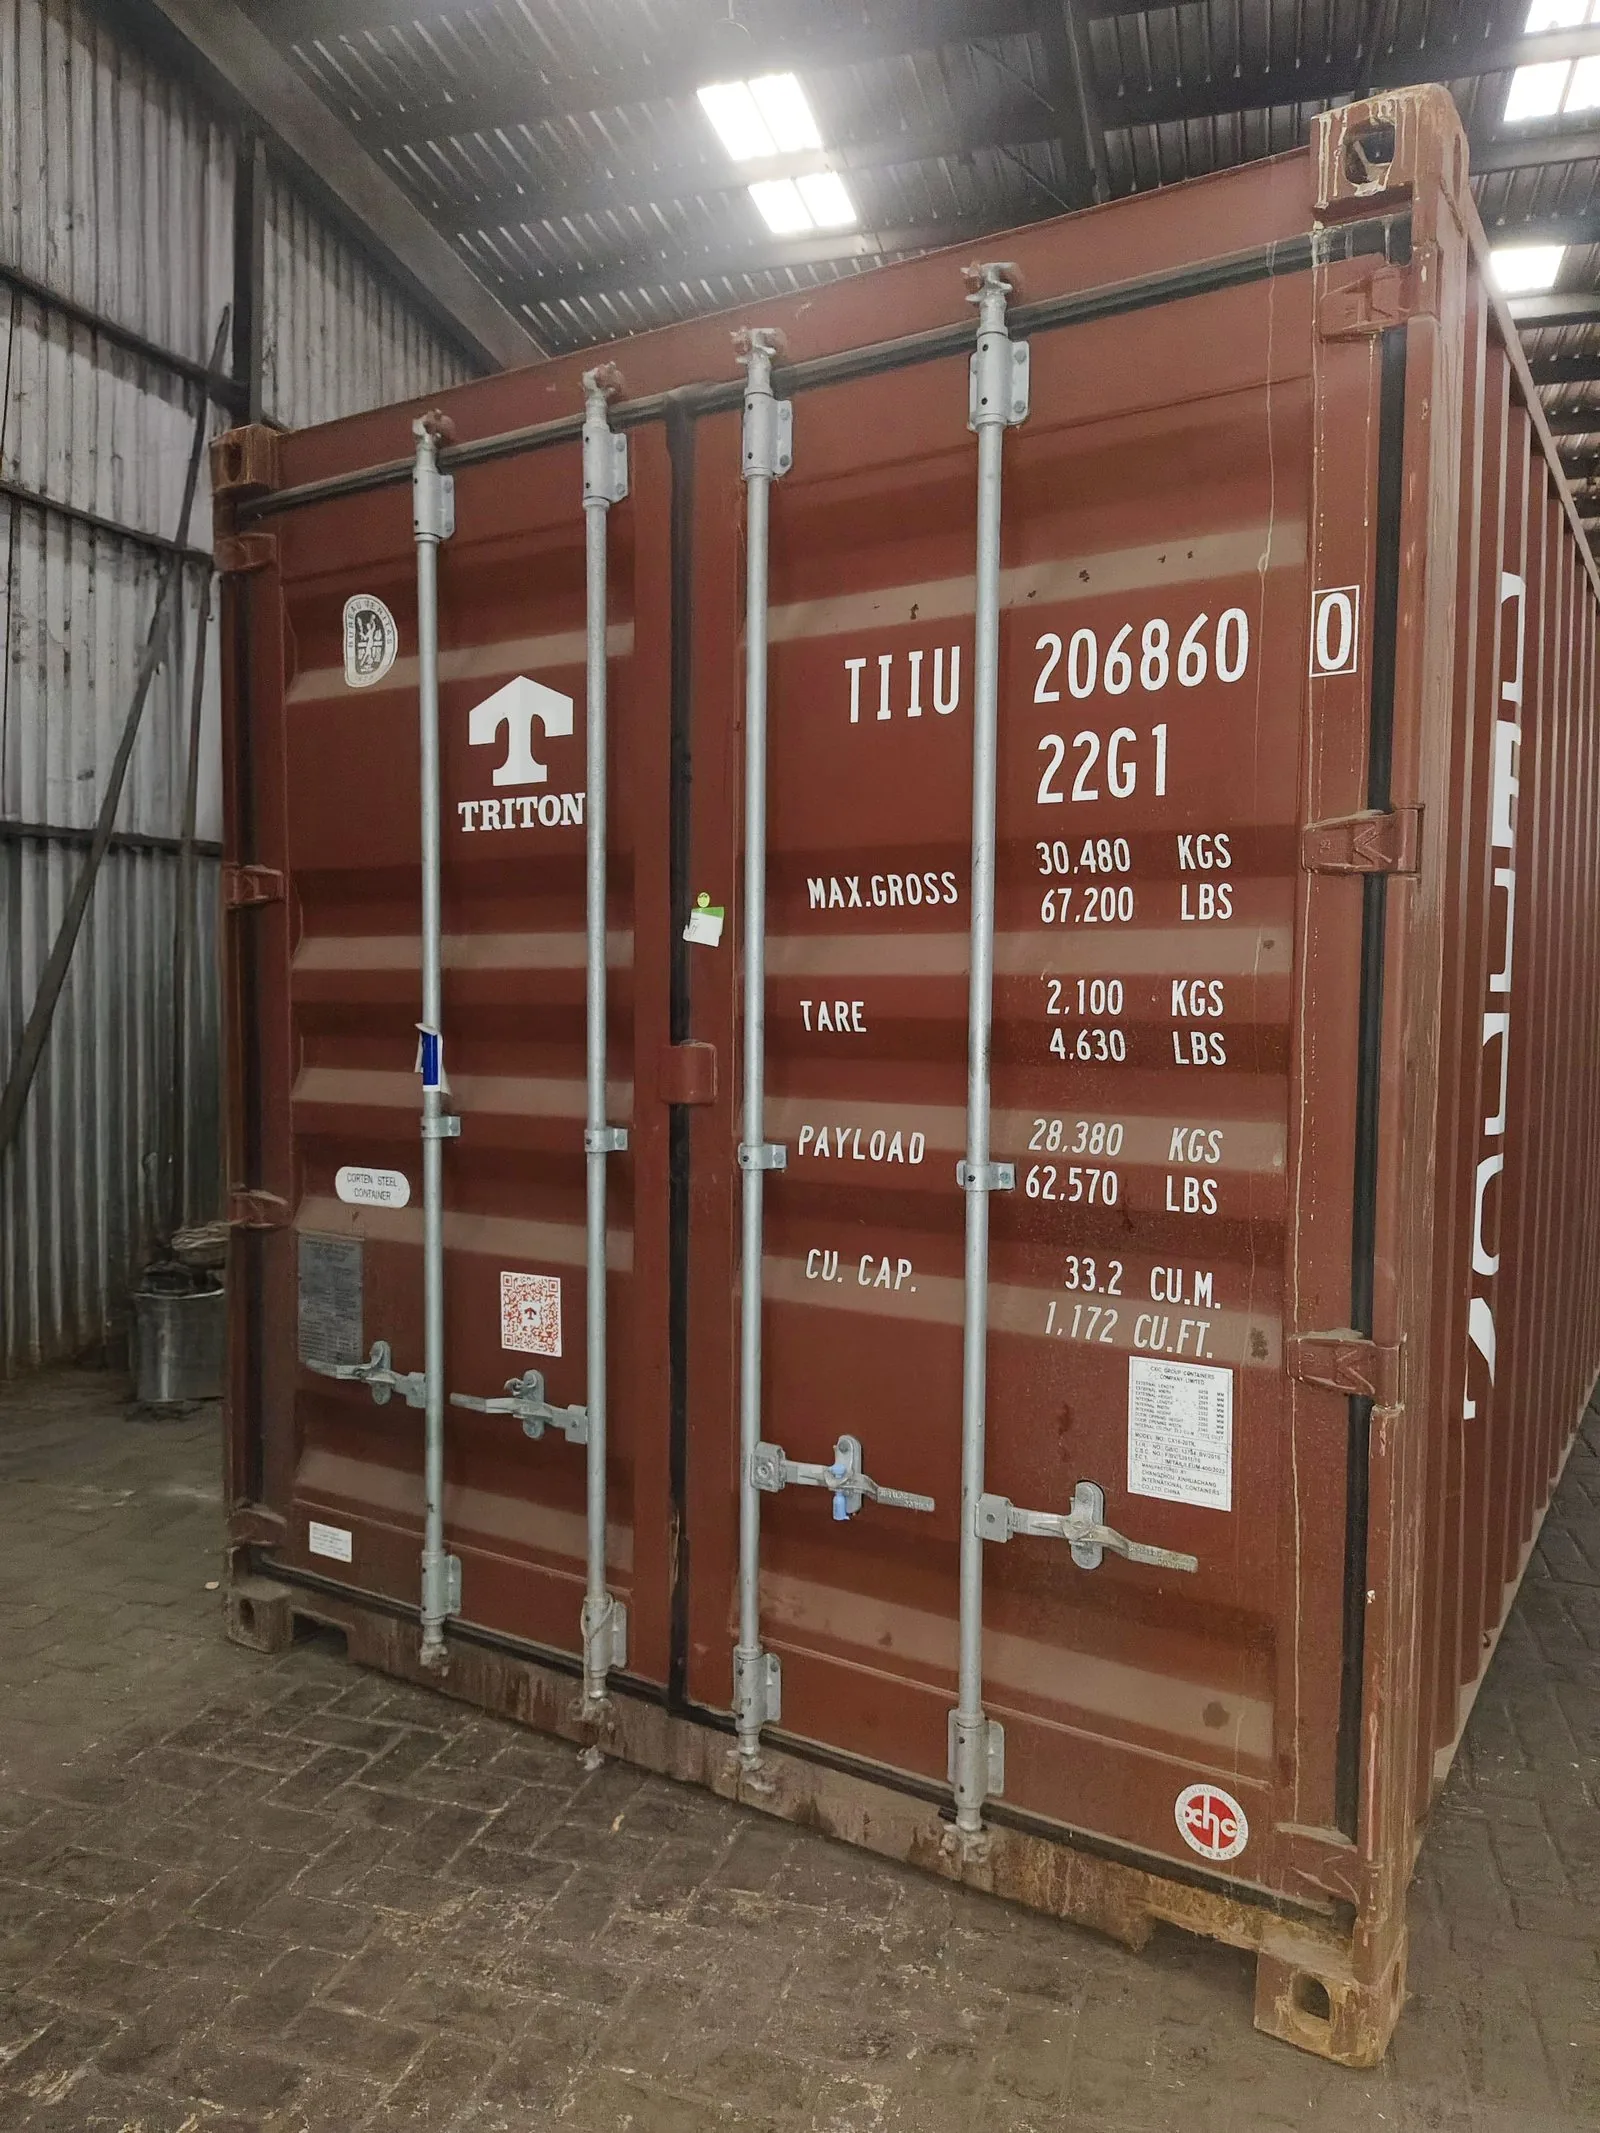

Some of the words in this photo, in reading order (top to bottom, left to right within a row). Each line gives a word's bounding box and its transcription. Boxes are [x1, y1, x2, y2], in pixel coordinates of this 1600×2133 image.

[844, 645, 961, 723] TIIU
[1033, 607, 1249, 704] 206860
[1317, 592, 1352, 672] 0
[1037, 723, 1167, 804] 22G1
[457, 792, 586, 832] TRITON
[807, 871, 958, 909] MAX.GROSS
[1036, 838, 1131, 875] 30,480
[1177, 833, 1232, 870] KGS
[1041, 886, 1134, 923] 67,200
[1181, 882, 1233, 921] LBS
[800, 1000, 867, 1032] TARE
[1046, 979, 1123, 1015] 2,100
[1171, 979, 1224, 1017] KGS
[1049, 1027, 1126, 1062] 4,630
[1172, 1031, 1227, 1066] LBS
[798, 1125, 925, 1164] PAYLOAD
[1028, 1118, 1124, 1157] 28,380
[1168, 1127, 1224, 1164] KGS
[354, 1187, 392, 1201] CONTAINER
[377, 1175, 398, 1188] STEEL
[1025, 1164, 1118, 1206] 62,570
[1166, 1175, 1218, 1215] LBS
[805, 1248, 843, 1283] CU.
[857, 1254, 917, 1292] CAP.
[1065, 1255, 1123, 1296] 33.2
[1150, 1266, 1221, 1309] CU.M.
[1045, 1301, 1119, 1344] 1,172
[1133, 1314, 1213, 1359] CU.FT.
[1160, 1374, 1182, 1382] COMPANY
[1185, 1378, 1205, 1386] LIMITED
[1183, 1370, 1215, 1380] CONTAINERS
[1135, 1432, 1152, 1440] MODEL
[1142, 1463, 1178, 1473] MANUFACTURED
[1142, 1476, 1183, 1489] INTERNATIONAL
[1185, 1484, 1220, 1496] CONTAINERS
[1164, 1487, 1180, 1496] CHINA
